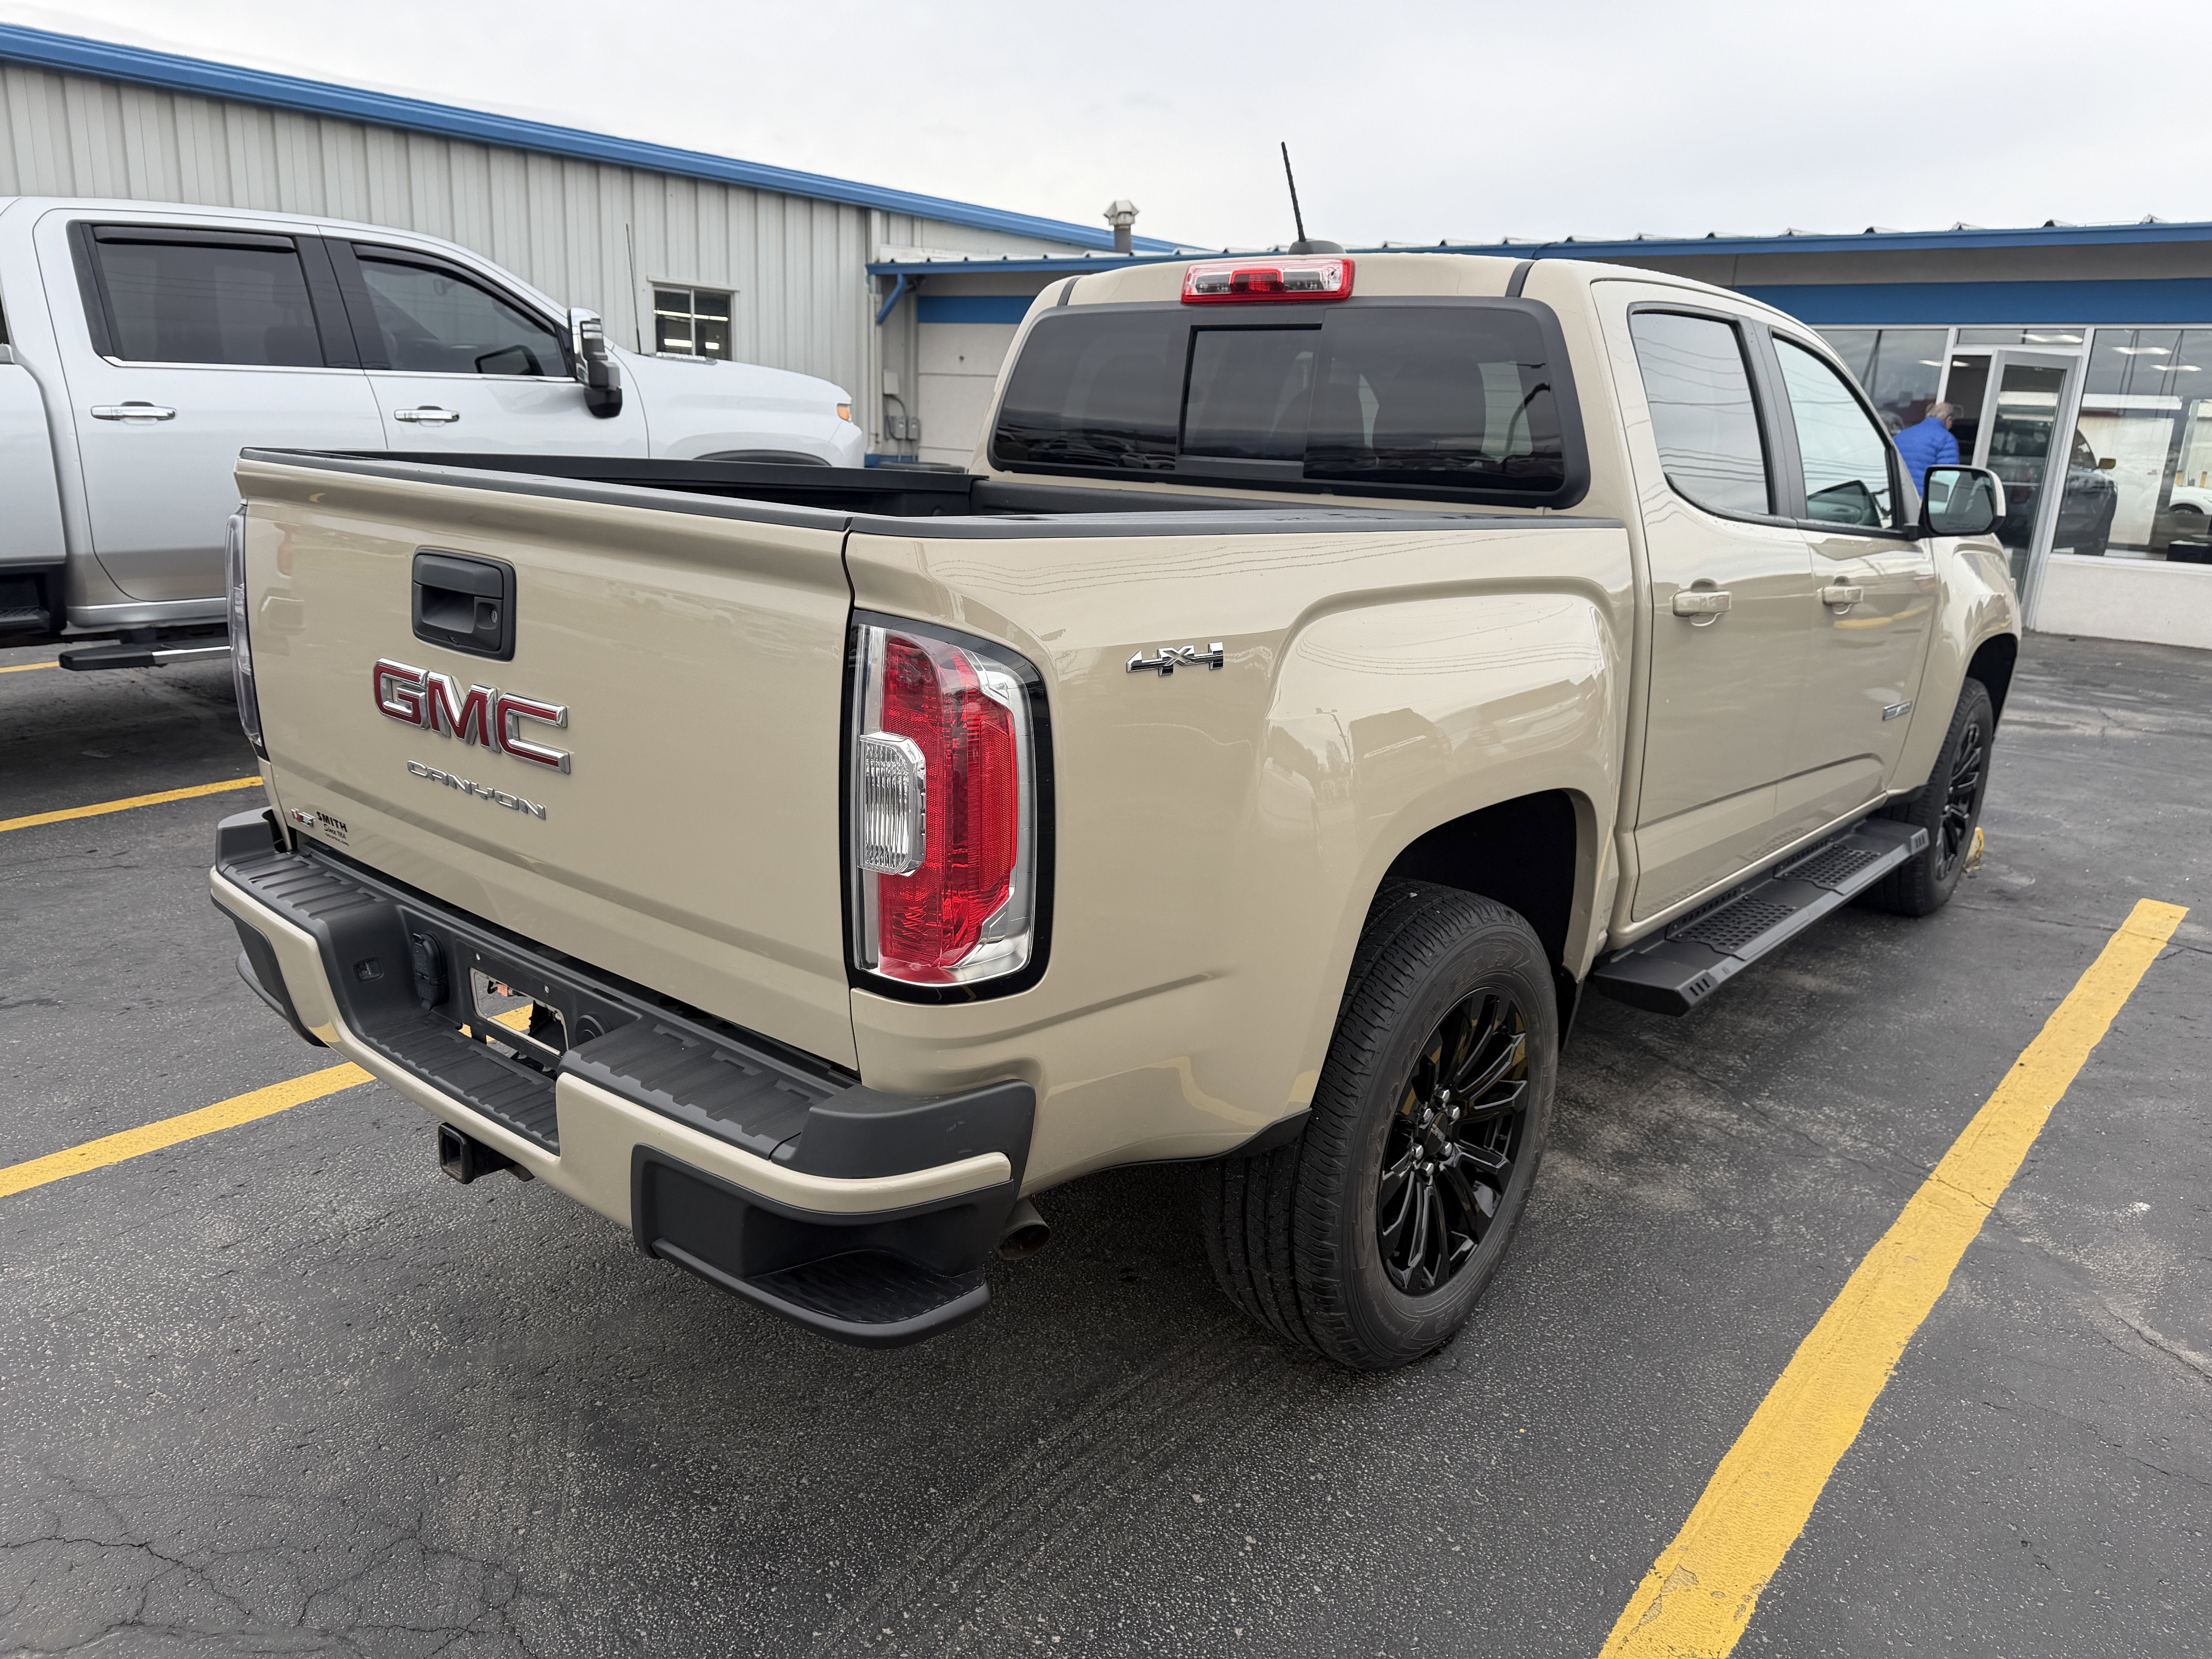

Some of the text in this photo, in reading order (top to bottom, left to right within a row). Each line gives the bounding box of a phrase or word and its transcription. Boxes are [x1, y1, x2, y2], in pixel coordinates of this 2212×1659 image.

[373, 657, 572, 775] GMC
[407, 760, 546, 820] CANYON
[316, 811, 348, 833] SMITH
